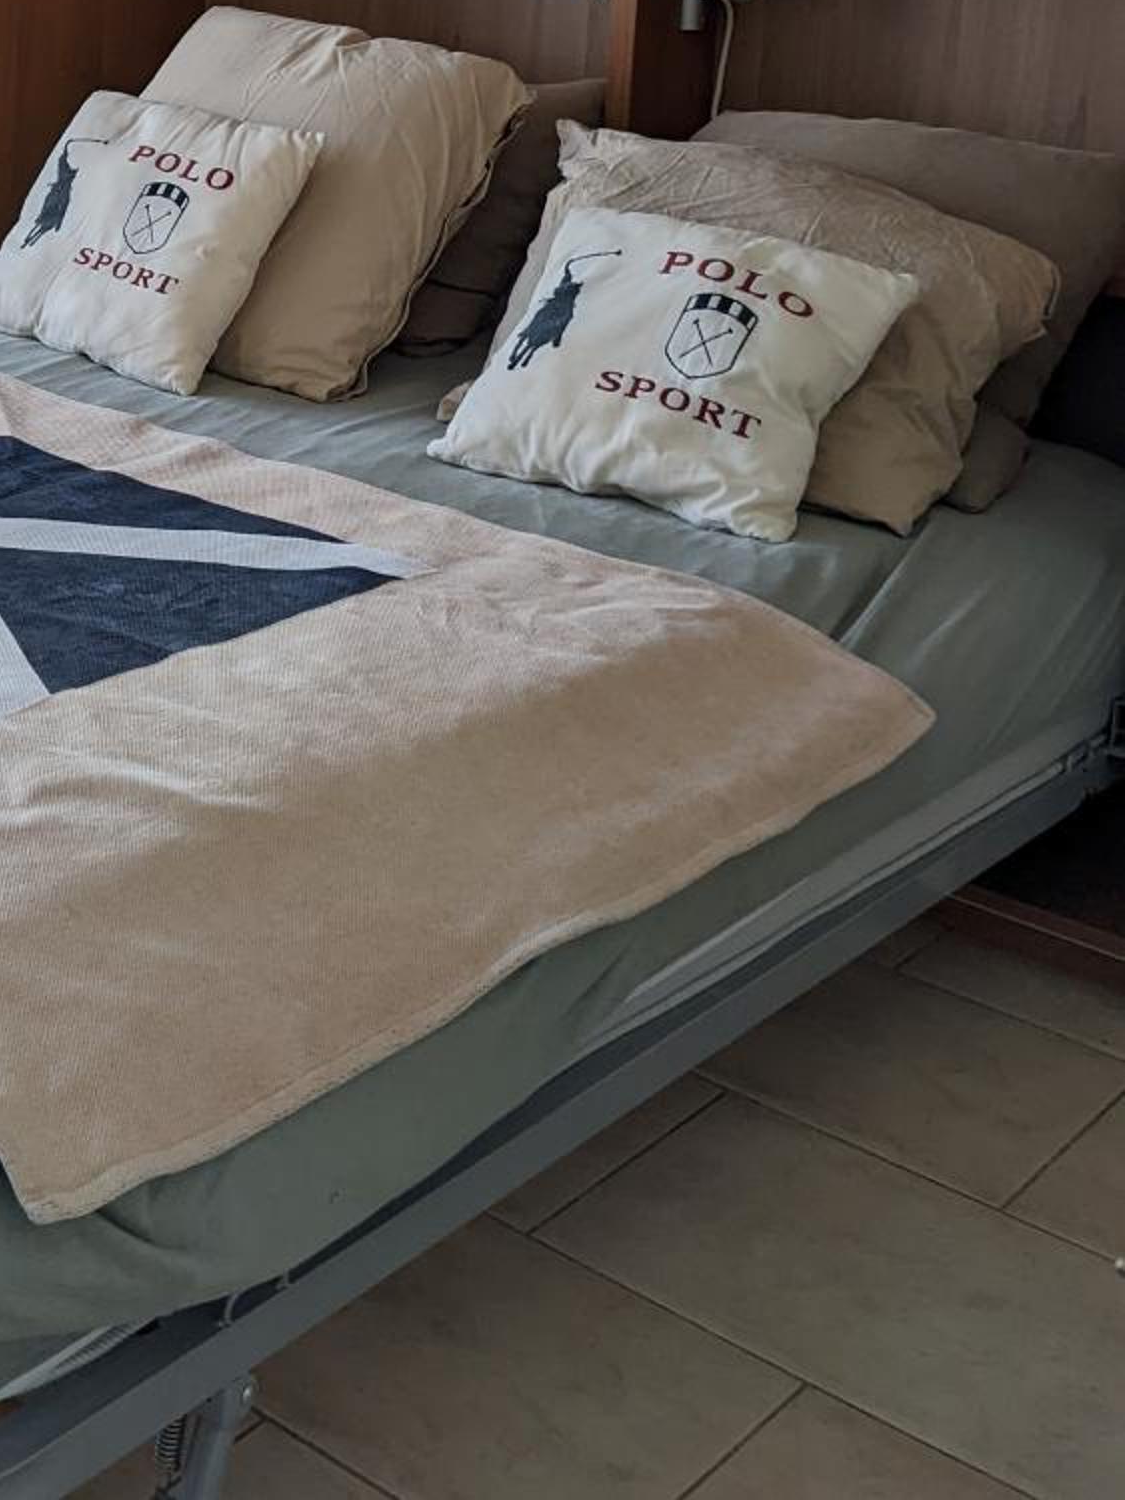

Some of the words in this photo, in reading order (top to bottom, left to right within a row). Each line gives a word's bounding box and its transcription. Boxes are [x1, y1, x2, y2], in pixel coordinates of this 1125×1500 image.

[128, 145, 235, 190] POLO
[73, 247, 180, 295] SPORT
[659, 251, 814, 317] POLO
[595, 371, 762, 439] SPORT
